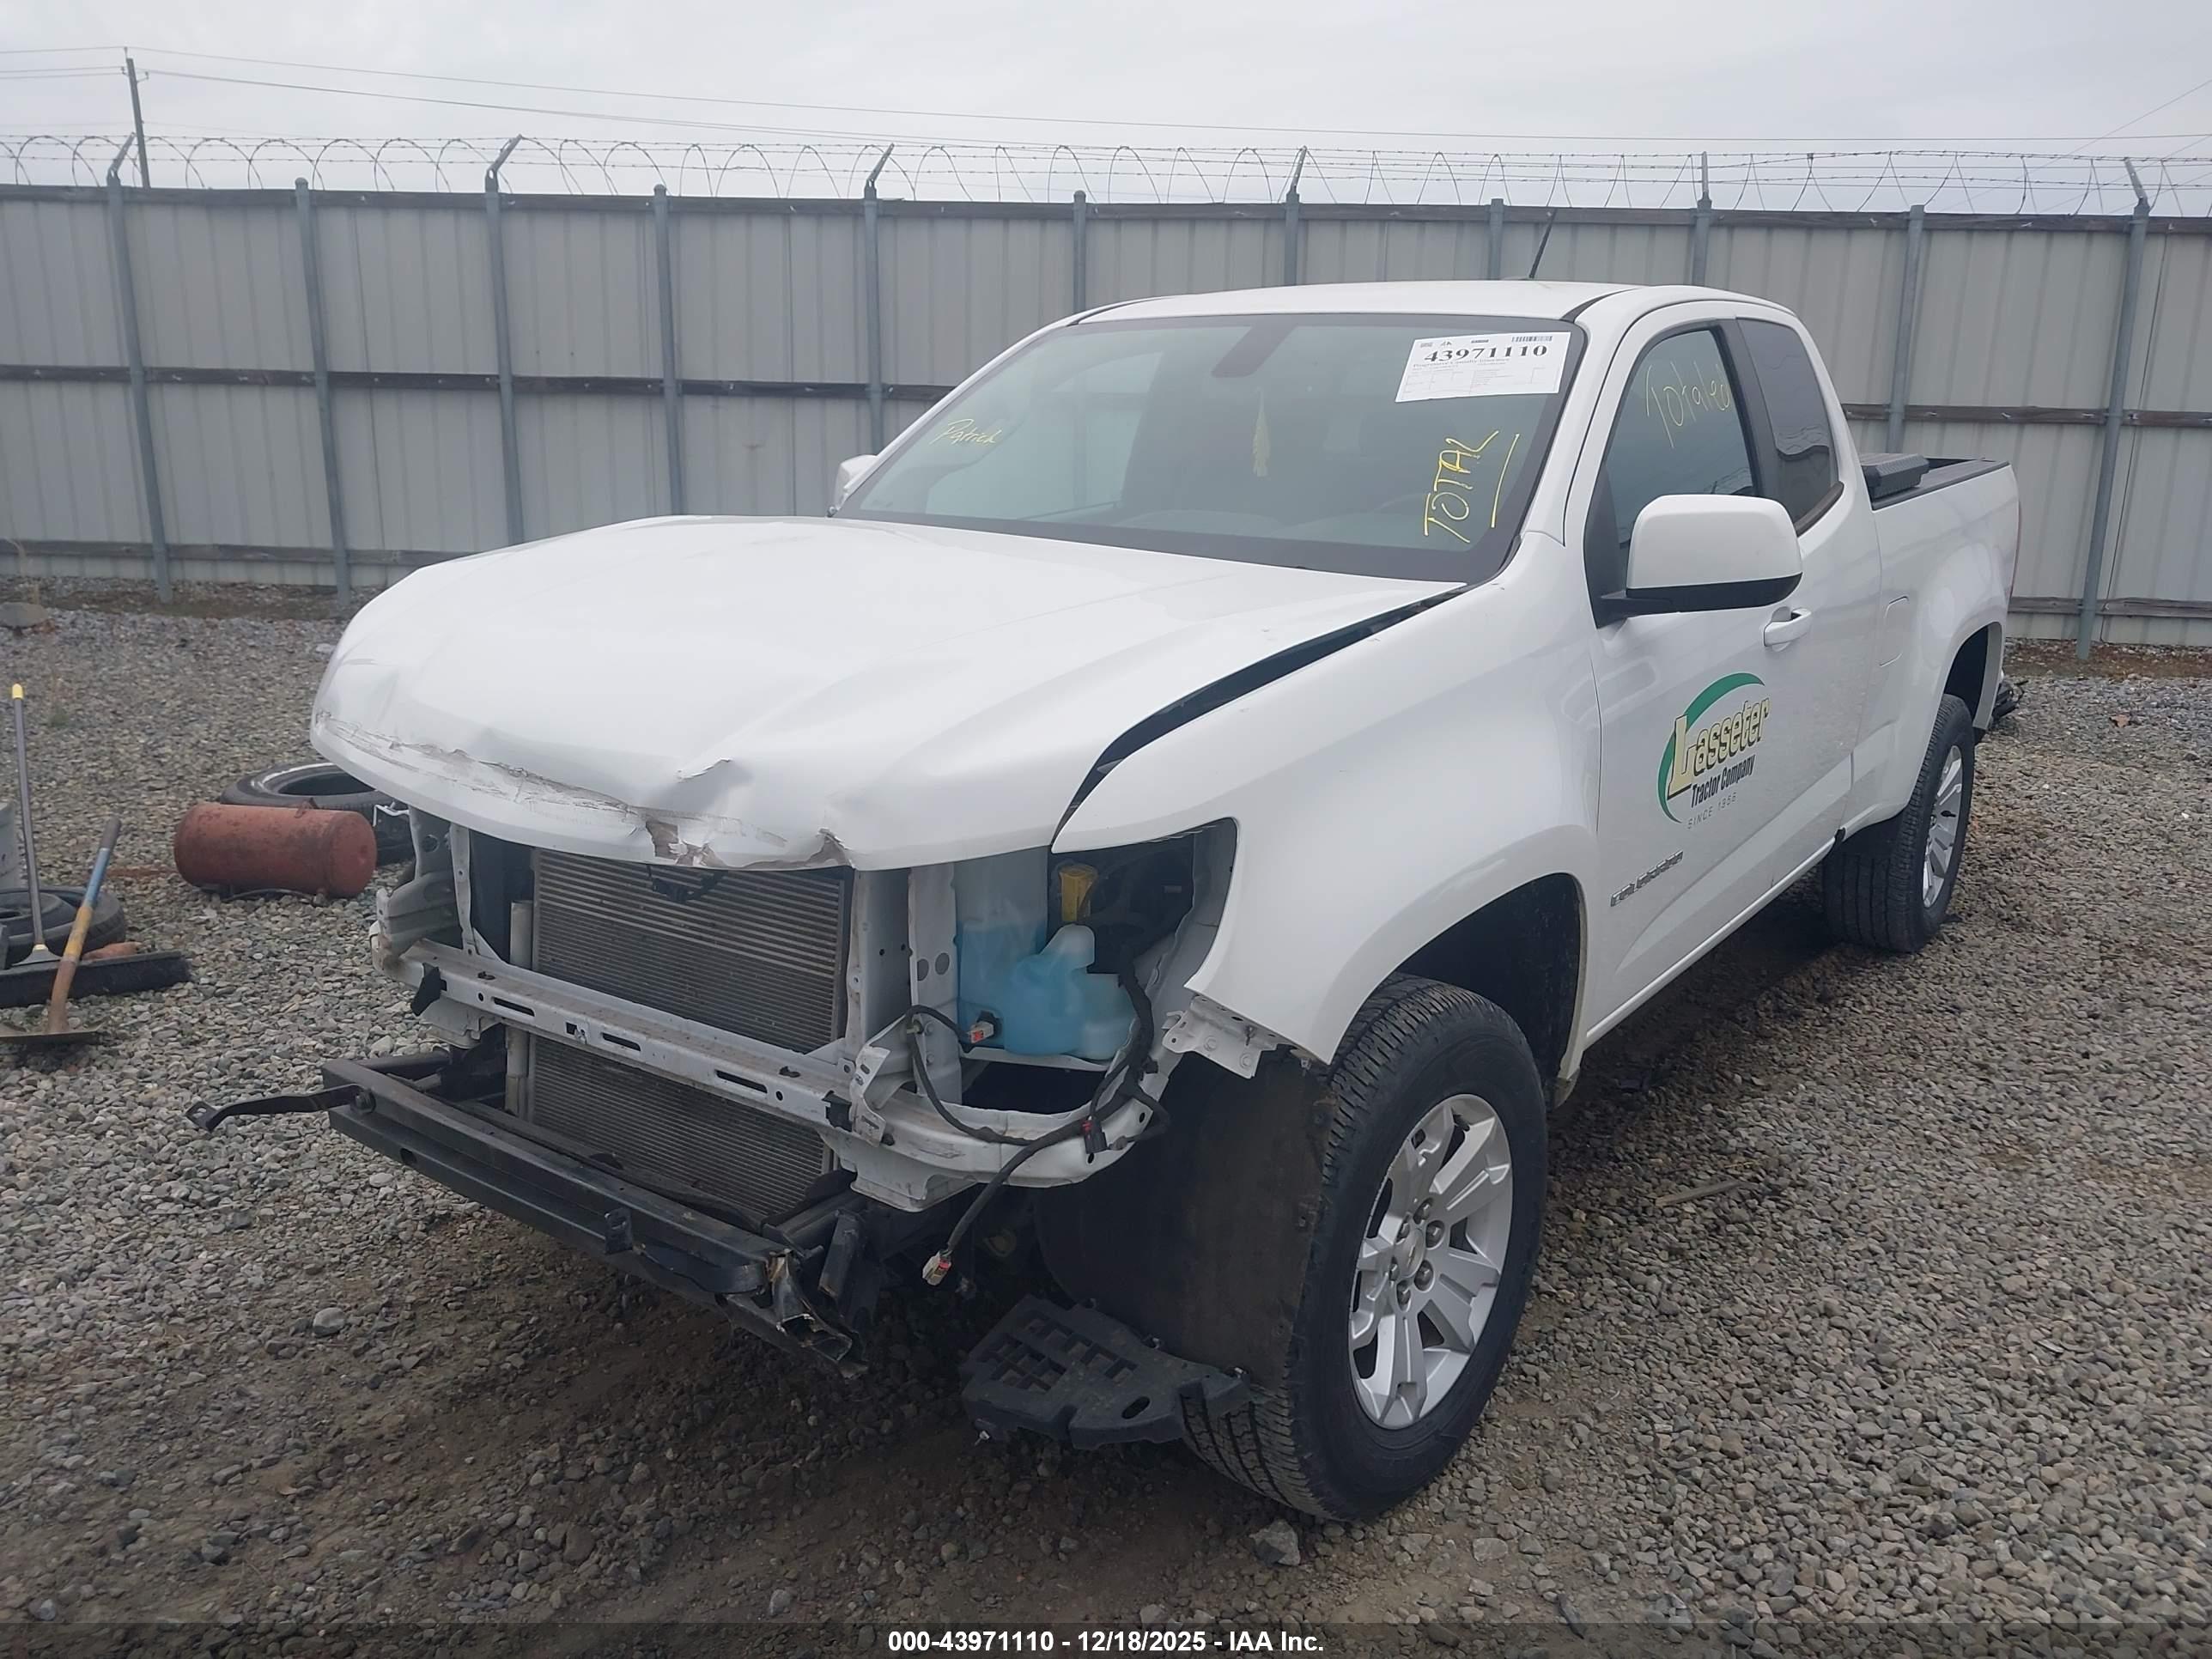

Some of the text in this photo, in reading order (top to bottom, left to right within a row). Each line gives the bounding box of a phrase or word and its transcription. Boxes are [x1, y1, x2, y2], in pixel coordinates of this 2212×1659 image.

[1425, 345, 1547, 362] 43971110
[1424, 430, 1499, 543] TOTAL
[1667, 697, 1770, 800] Lasseter
[1691, 754, 1755, 808] Tractor Company
[1687, 805, 1713, 830] SINCE
